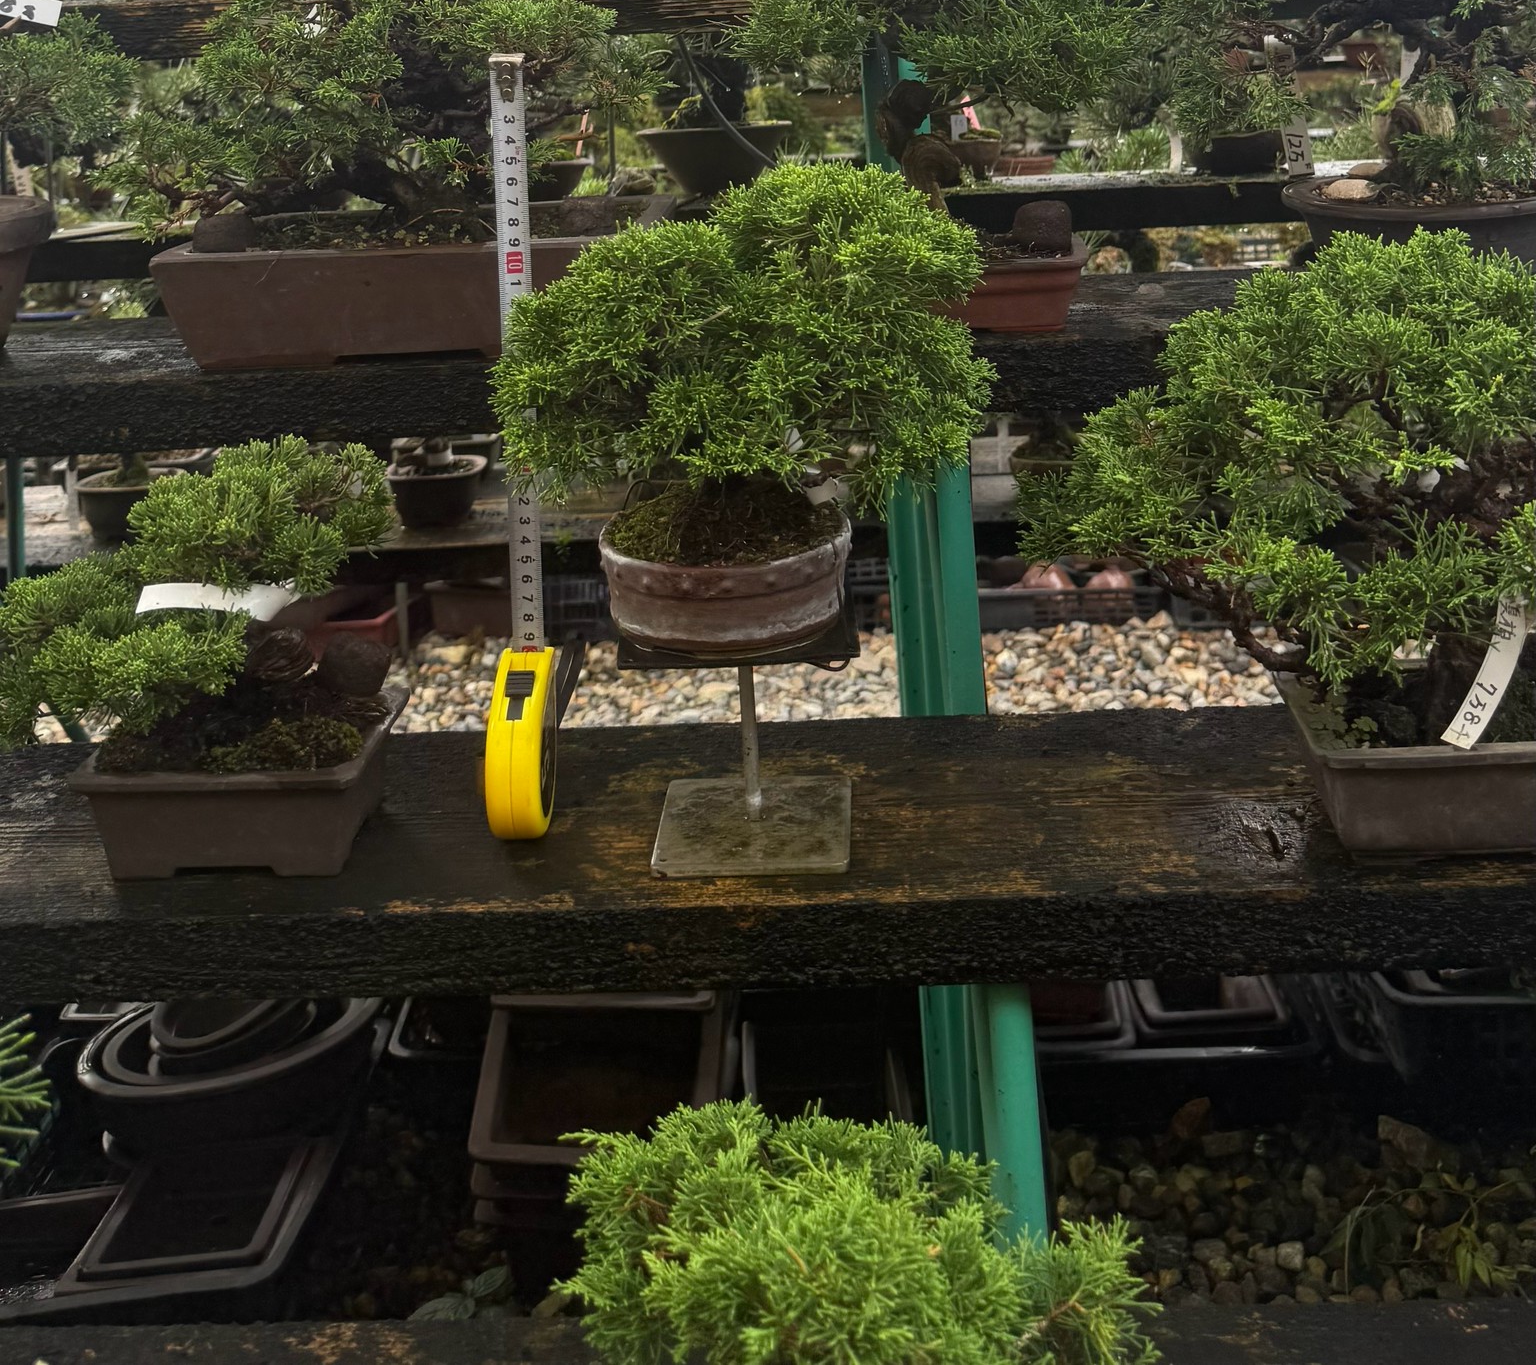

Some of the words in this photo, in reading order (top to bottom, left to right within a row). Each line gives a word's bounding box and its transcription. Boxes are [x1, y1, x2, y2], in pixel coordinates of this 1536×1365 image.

[503, 115, 515, 124] 3
[504, 135, 516, 145] 4
[505, 156, 518, 165] 5
[506, 177, 518, 187] 6
[507, 197, 519, 206] 7
[508, 217, 520, 227] 8
[508, 237, 520, 247] 9
[508, 255, 522, 269] 10
[519, 497, 530, 506] 2
[519, 516, 531, 525] 3
[520, 536, 531, 545] 4
[521, 555, 532, 564] 5
[521, 575, 533, 584] 6
[522, 594, 534, 602] 7
[523, 613, 534, 622] 8
[524, 632, 535, 641] 9
